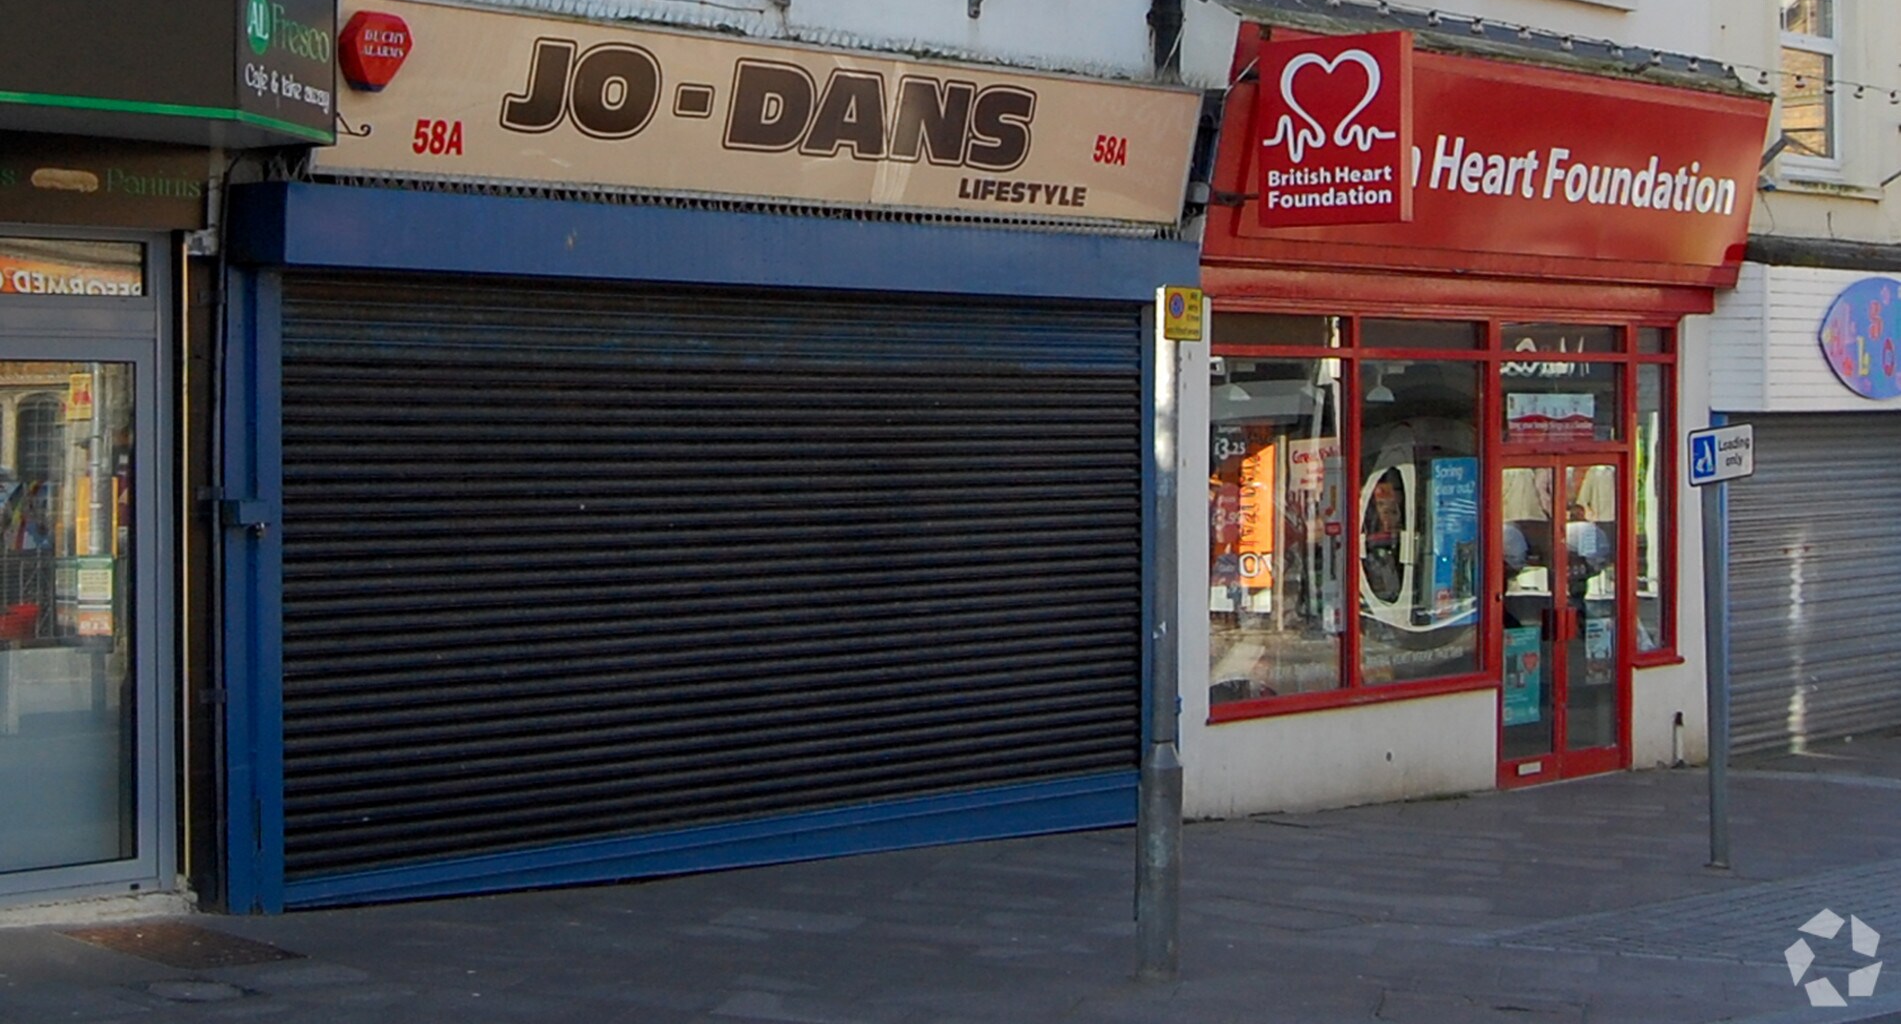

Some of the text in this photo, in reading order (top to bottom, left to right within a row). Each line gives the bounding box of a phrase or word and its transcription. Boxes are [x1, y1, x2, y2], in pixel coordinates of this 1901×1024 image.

[272, 3, 330, 64] Fresco
[364, 29, 406, 44] DUCHY
[362, 45, 405, 58] ALARMS
[412, 118, 464, 156] 58A
[1093, 133, 1129, 167] 58A
[107, 167, 201, 197] Paninis
[1268, 167, 1331, 187] British
[1335, 164, 1392, 183] Heart
[1429, 134, 1539, 200] Heart
[1544, 145, 1738, 216] Foundation
[958, 178, 1087, 208] LIFESTYLE
[1268, 186, 1392, 209] Foundation
[1718, 435, 1750, 452] Loading
[1725, 452, 1743, 466] only
[1434, 464, 1463, 480] Spring
